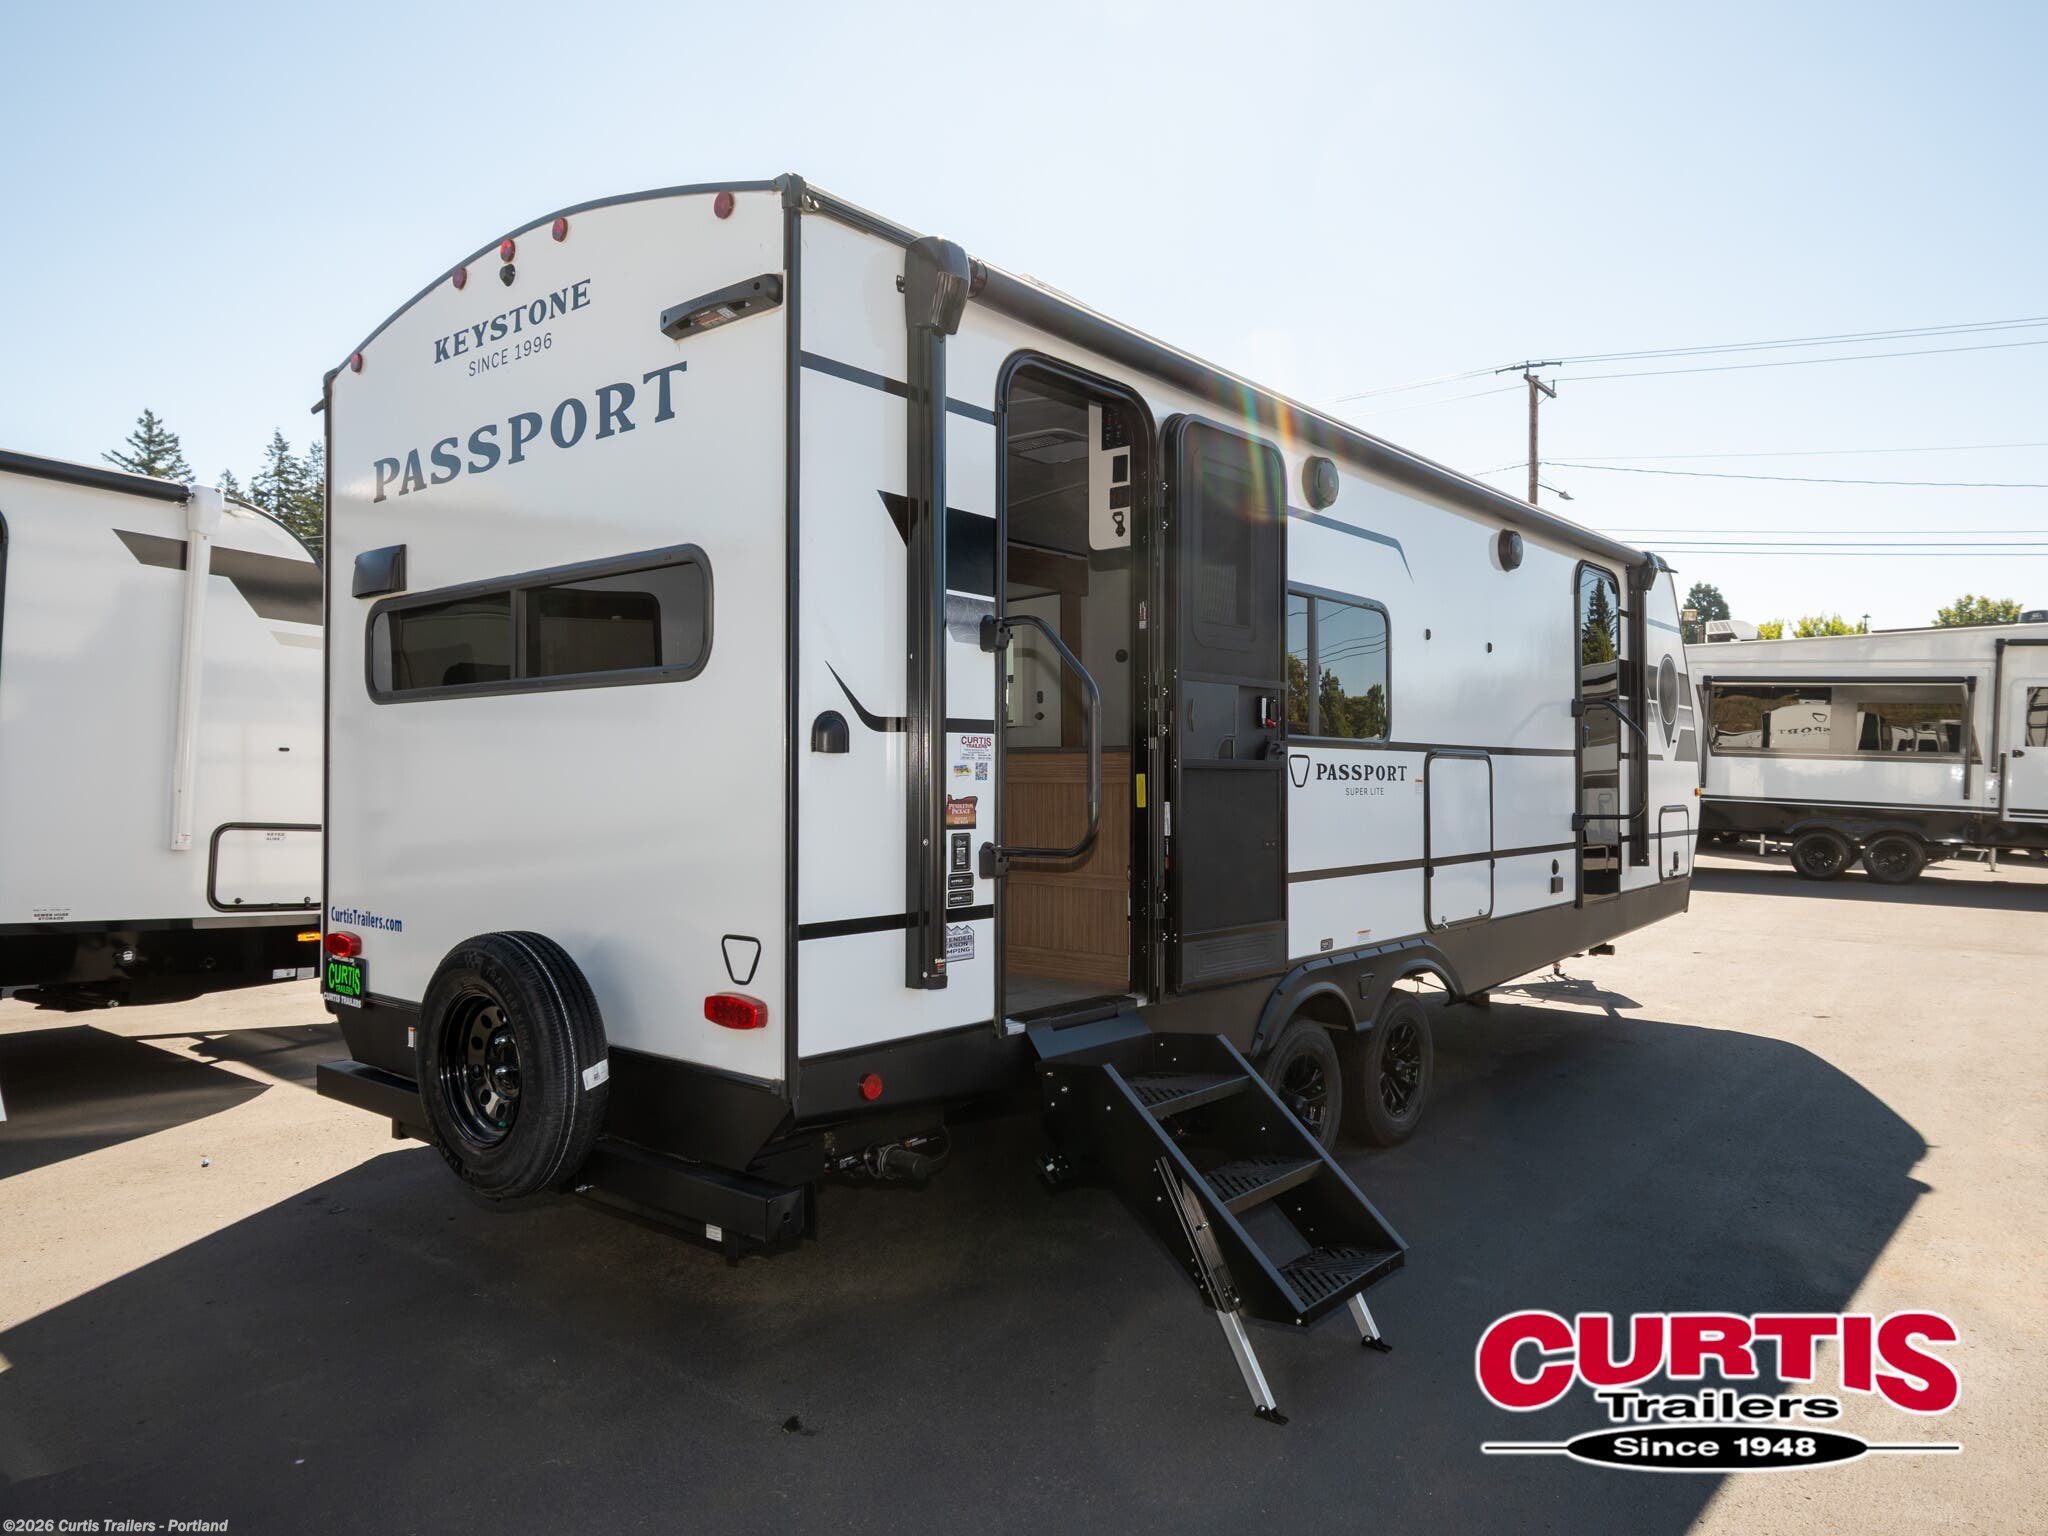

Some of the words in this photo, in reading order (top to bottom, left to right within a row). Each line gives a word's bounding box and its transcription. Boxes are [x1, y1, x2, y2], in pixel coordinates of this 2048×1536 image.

[434, 278, 591, 364] KEYSTONE
[468, 348, 509, 377] SINCE
[515, 332, 552, 360] 1996
[373, 361, 687, 503] PASSPORT
[961, 736, 992, 747] CURTIS
[1316, 763, 1407, 781] PASSPORT
[1345, 787, 1369, 796] SUPER
[1370, 787, 1384, 796] LITE
[331, 906, 402, 932] CurtisTrailers.com
[328, 963, 361, 996] CURTIS
[335, 984, 354, 995] TRAILERS
[323, 992, 341, 1002] CURTIS
[341, 995, 362, 1008] TRAILERS
